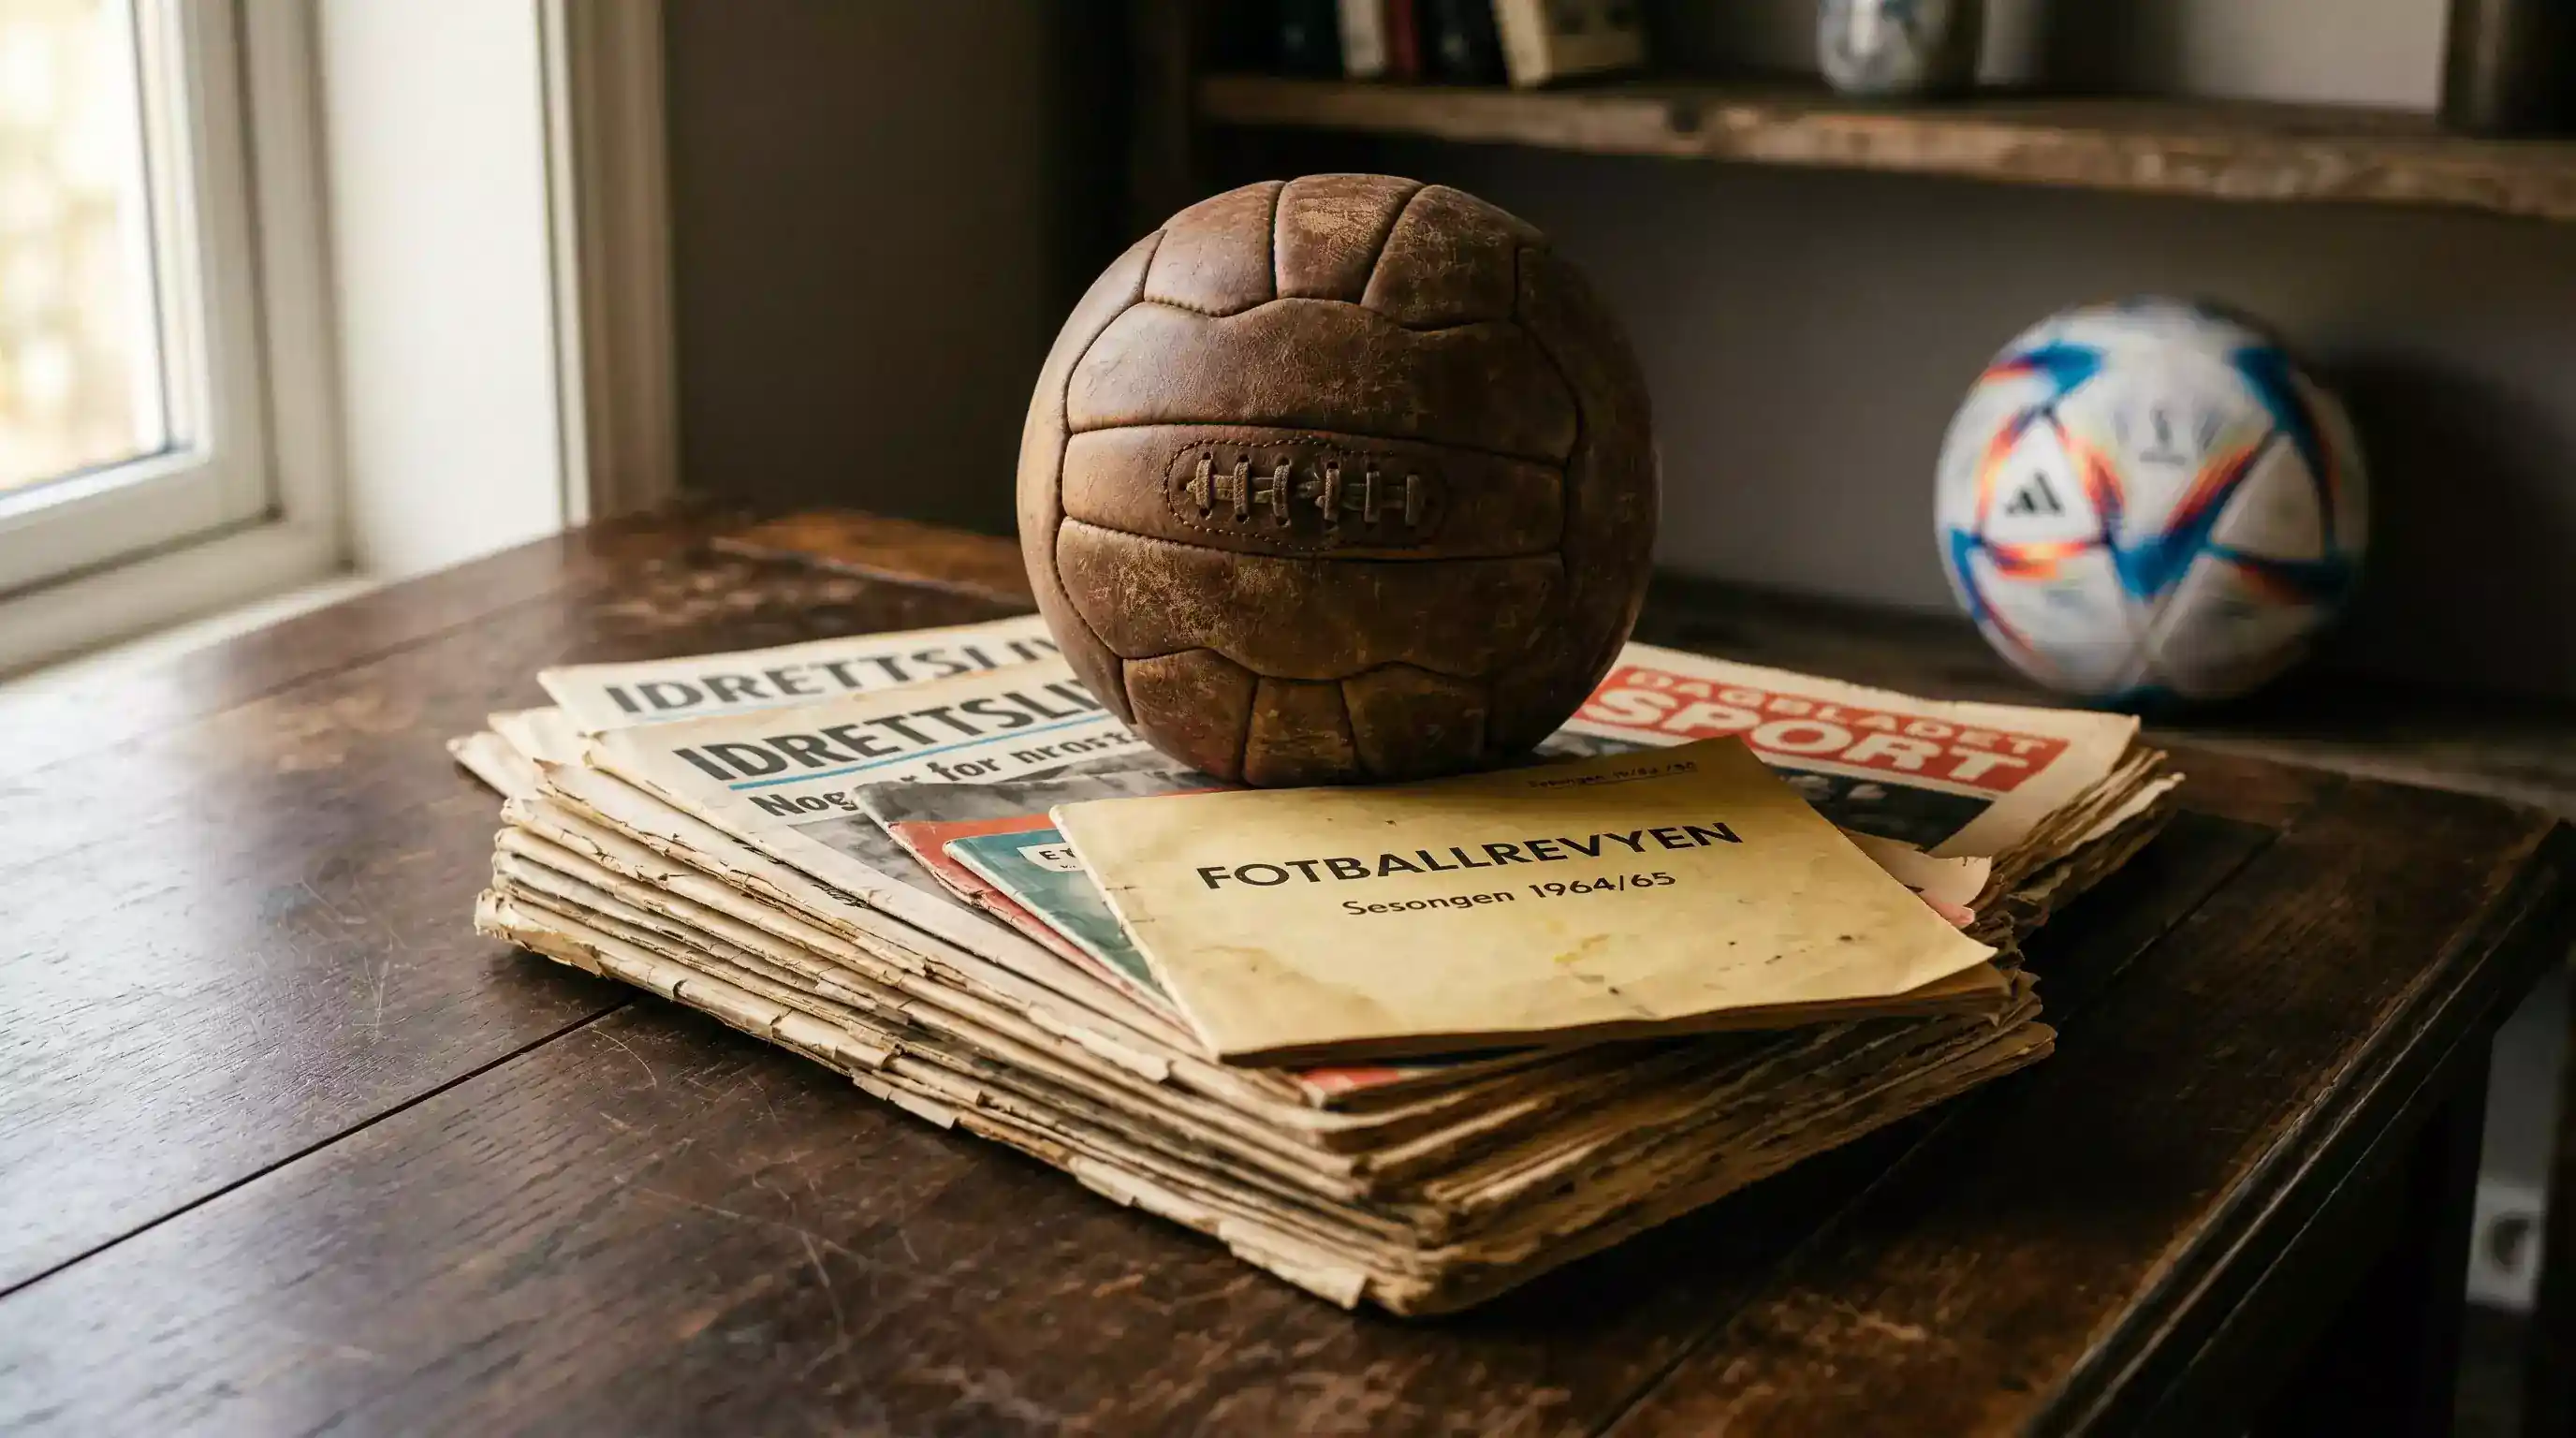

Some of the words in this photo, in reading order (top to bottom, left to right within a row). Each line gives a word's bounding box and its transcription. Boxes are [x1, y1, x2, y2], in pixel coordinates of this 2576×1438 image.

[672, 679, 1103, 782] IDRETTSLI
[1583, 688, 2029, 782] SPORT
[1626, 668, 2047, 755] DAGBLADET
[926, 756, 1001, 782] for
[1195, 821, 1743, 889] FOTBALLREVYEN
[1342, 889, 1515, 917] Sesongen
[1529, 871, 1676, 900] 1964/65
